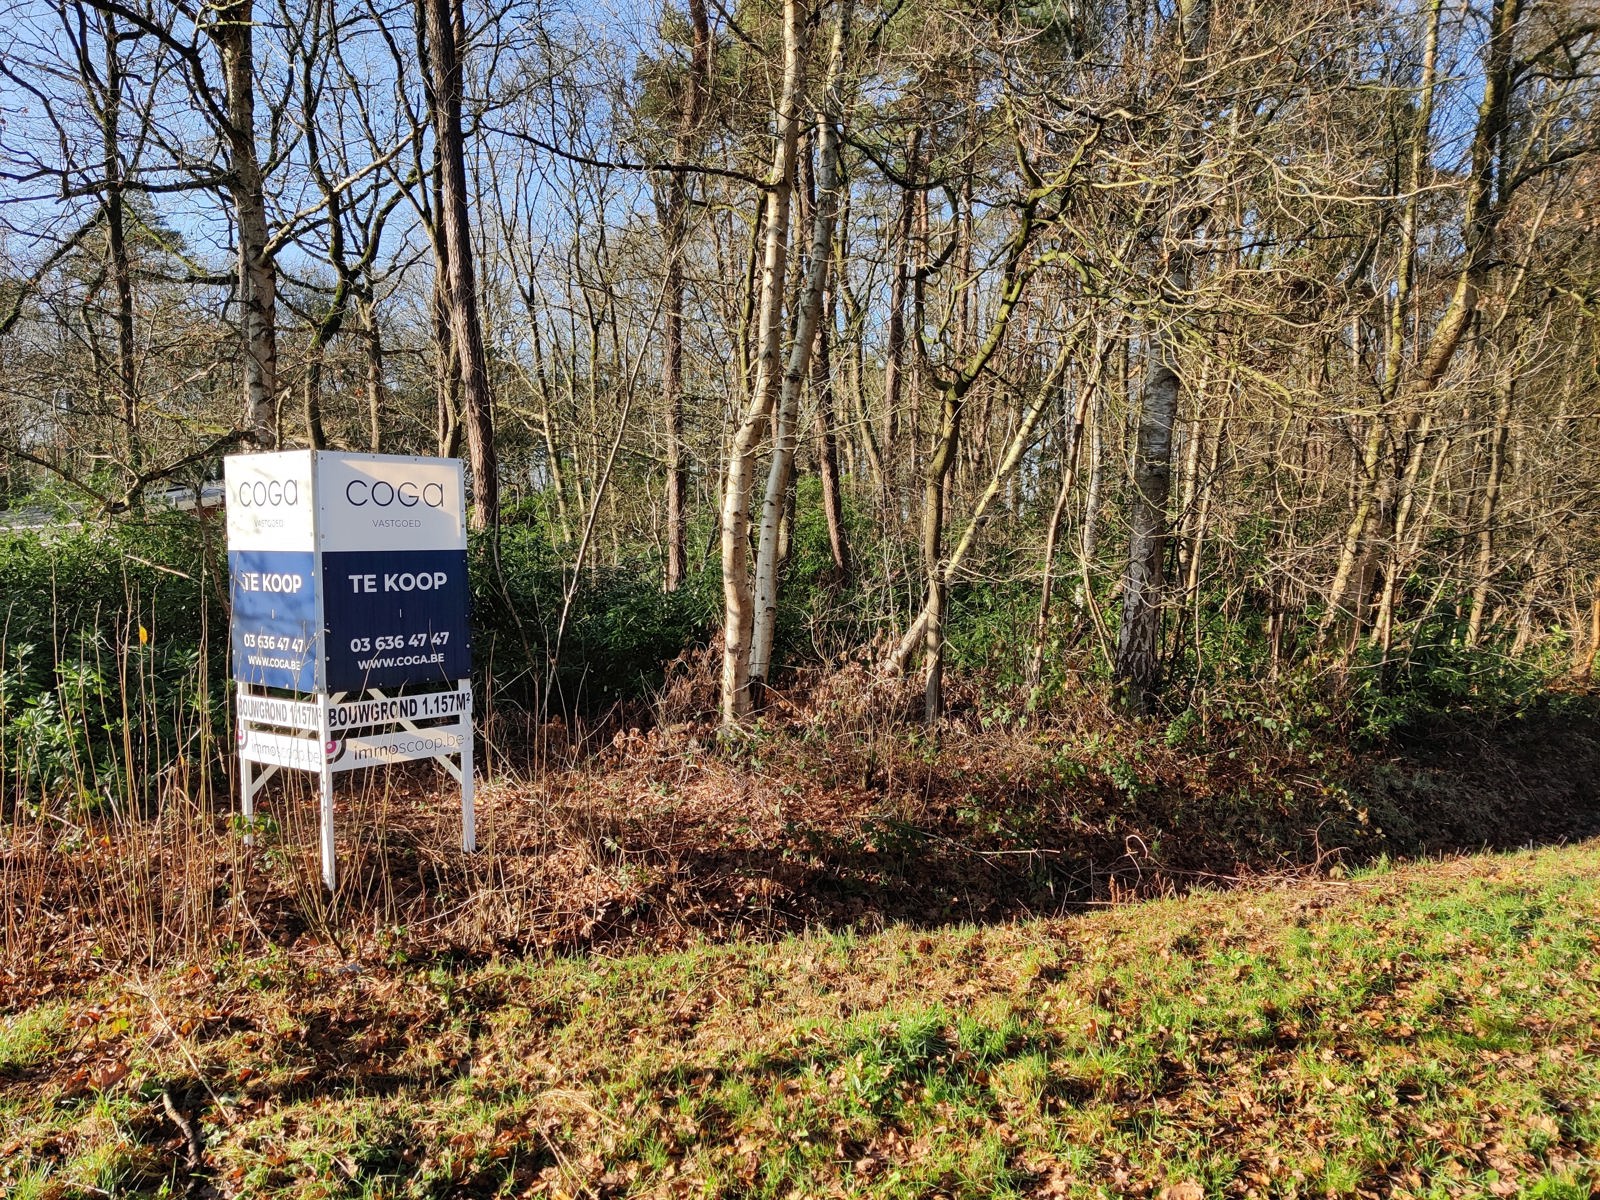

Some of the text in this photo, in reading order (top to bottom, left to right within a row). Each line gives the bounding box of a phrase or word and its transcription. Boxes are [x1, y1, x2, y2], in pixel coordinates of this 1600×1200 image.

[372, 519, 421, 528] VASTGOED
[242, 573, 302, 593] TE KOOP
[348, 572, 448, 594] TE KOOP
[244, 634, 304, 653] 03 636 47 47
[350, 631, 450, 653] 03 636 47 47
[247, 655, 301, 671] WWW.COGA.BE
[357, 652, 445, 670] WWW.COGA.BE
[328, 697, 418, 727] BOUWGROND
[353, 733, 465, 761] immoscoop.be
